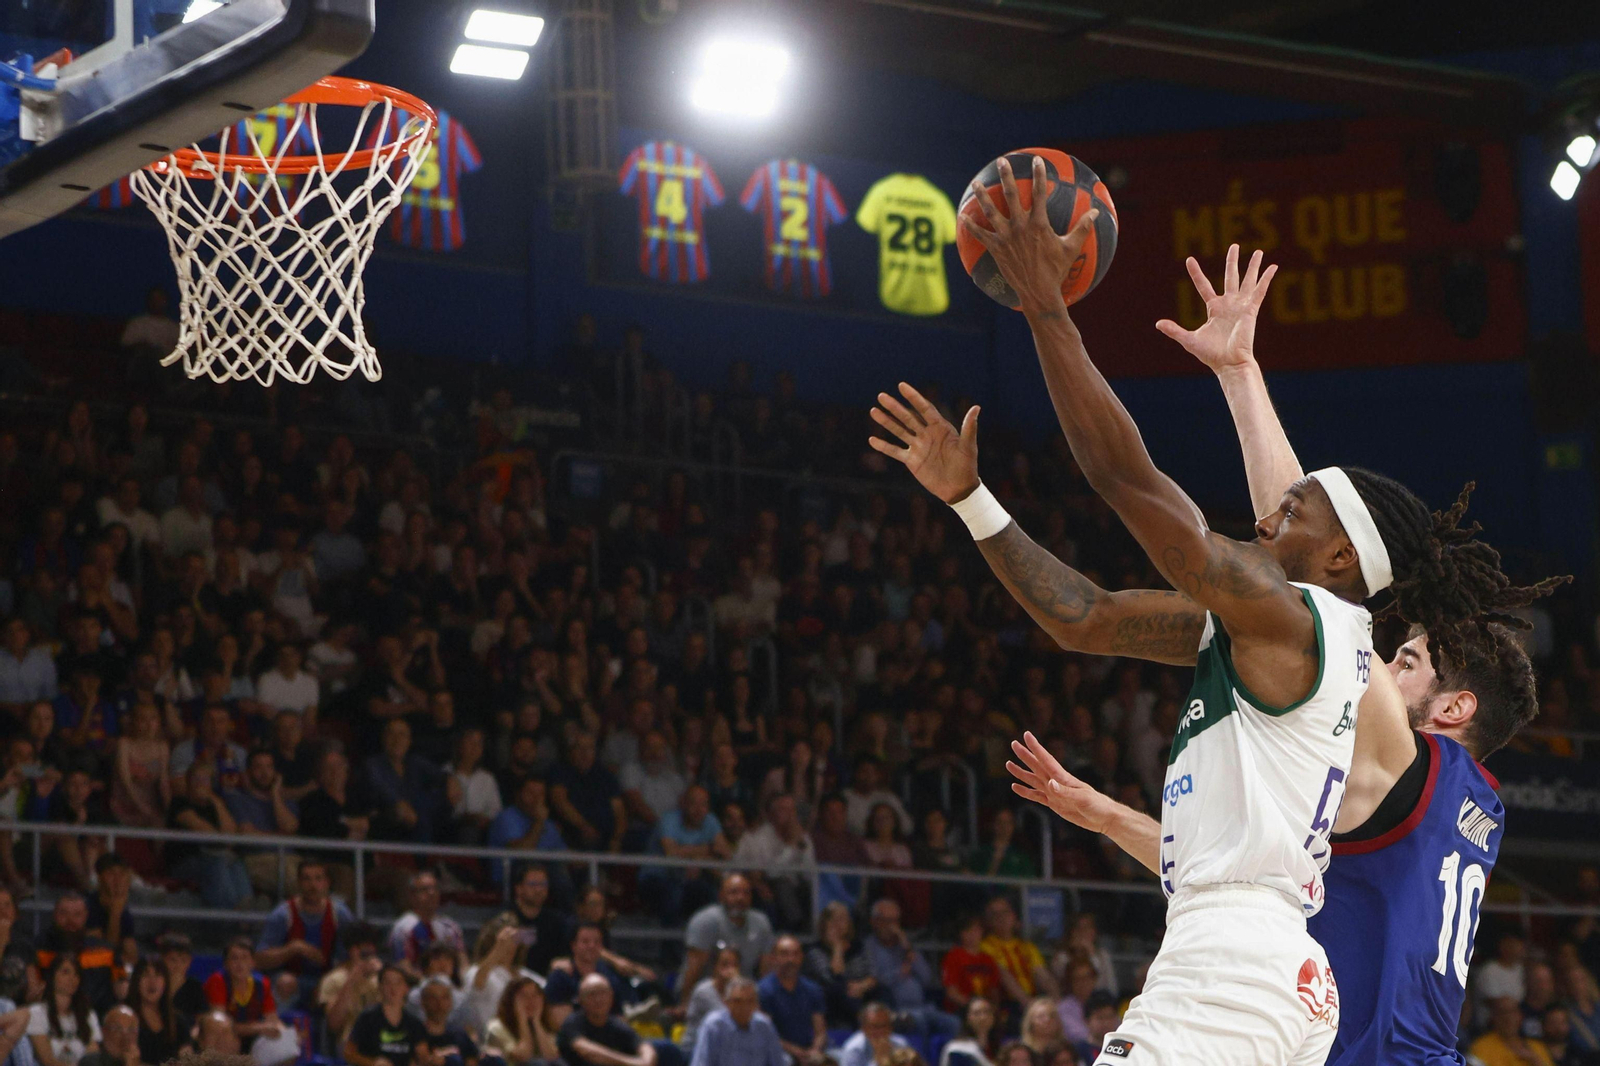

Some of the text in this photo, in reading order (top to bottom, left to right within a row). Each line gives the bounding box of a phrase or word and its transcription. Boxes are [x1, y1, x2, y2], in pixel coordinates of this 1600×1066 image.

[656, 178, 687, 223] 4
[780, 198, 808, 242] 2
[1172, 176, 1406, 264] MÉS QUE
[887, 213, 935, 255] 28
[1271, 262, 1407, 324] CLUB
[1431, 851, 1486, 990] 10
[1106, 1045, 1125, 1055] acb
